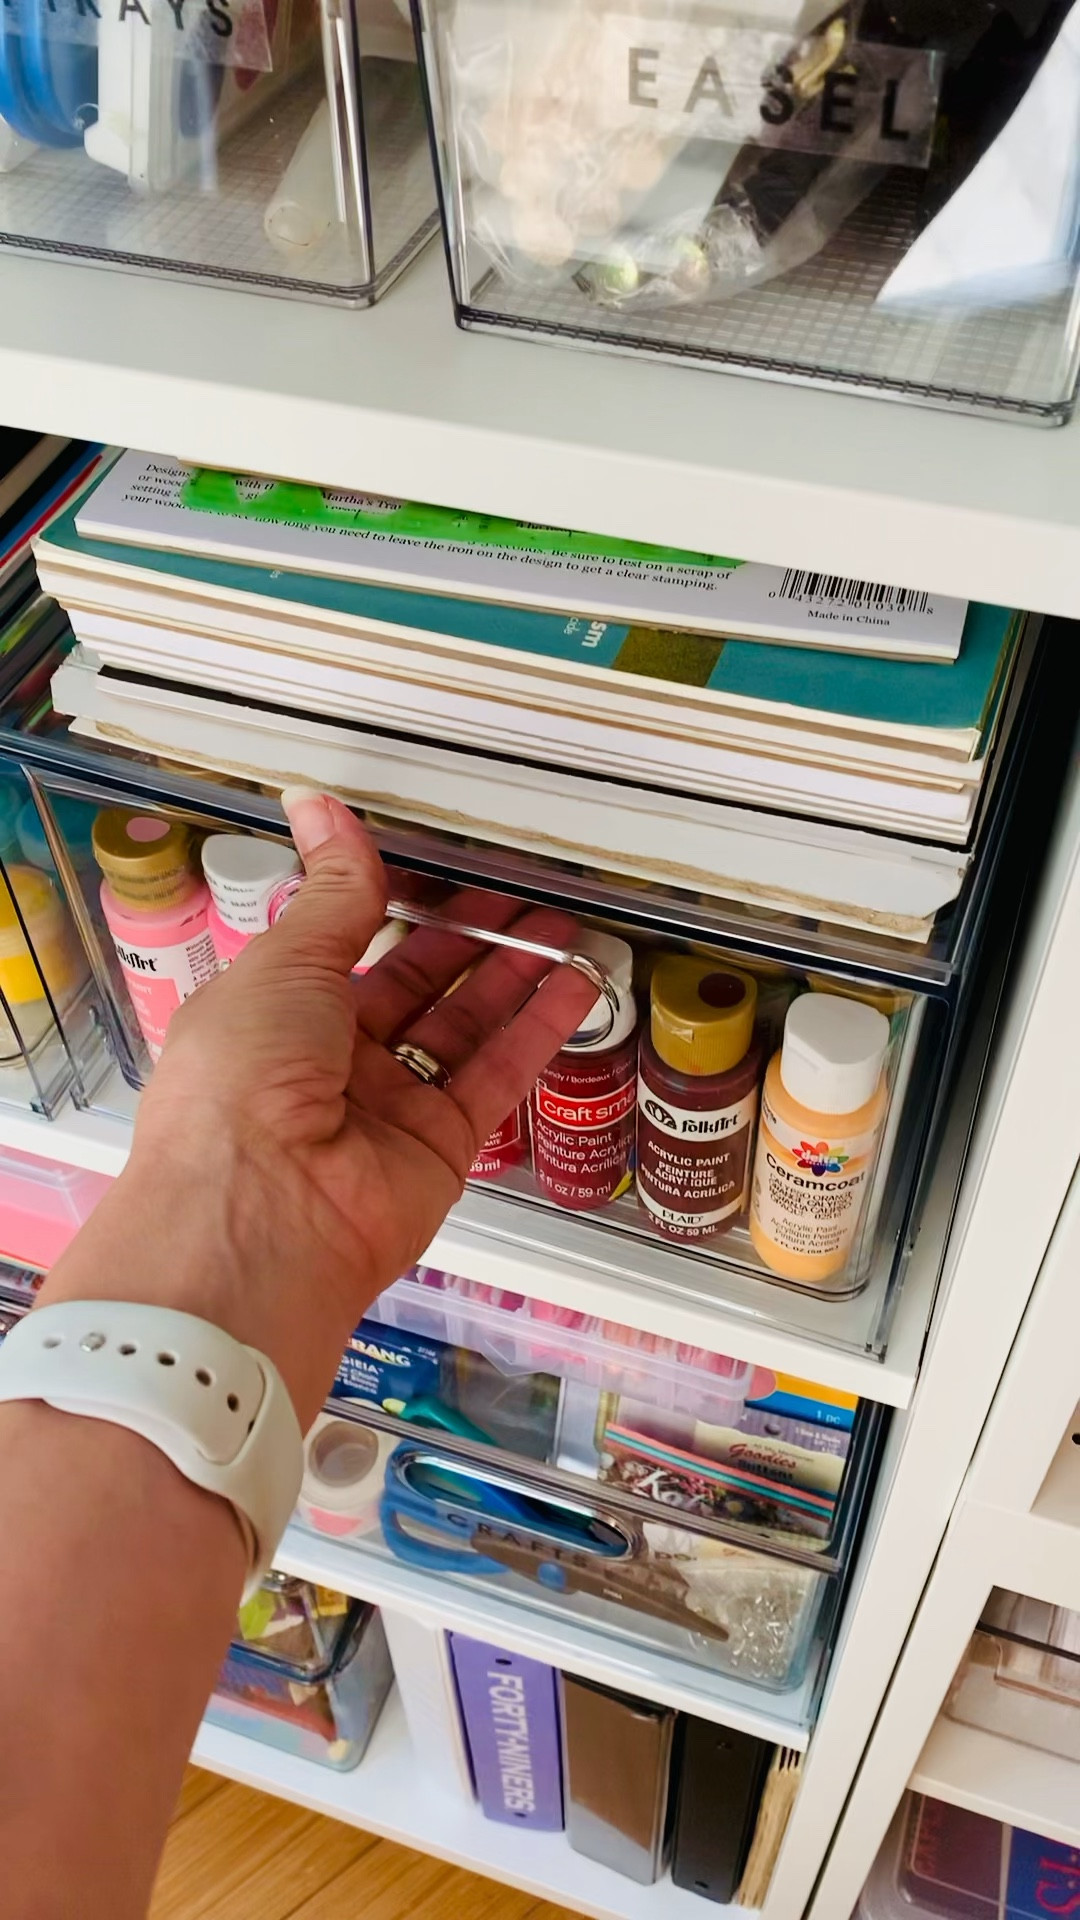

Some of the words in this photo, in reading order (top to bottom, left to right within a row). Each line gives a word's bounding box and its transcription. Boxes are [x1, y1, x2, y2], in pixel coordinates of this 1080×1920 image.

[627, 45, 911, 142] EASEL
[146, 464, 191, 478] Designs
[320, 490, 372, 507] Martha's
[122, 494, 152, 505] your
[313, 525, 337, 535] you
[339, 527, 370, 540] need
[372, 532, 386, 542] to
[388, 534, 421, 547] leave
[424, 540, 445, 551] the
[447, 543, 474, 556] iron
[476, 550, 493, 559] on
[497, 551, 518, 563] the
[520, 555, 563, 570] design
[566, 561, 579, 571] to
[581, 565, 602, 575] get
[617, 569, 650, 581] clear
[652, 574, 718, 591] stamping.
[130, 484, 172, 497] setting
[570, 551, 599, 562] sure
[602, 556, 616, 565] to
[619, 560, 642, 569] test
[645, 563, 663, 572] on
[677, 568, 714, 580] scrap
[716, 571, 733, 581] of
[807, 610, 839, 621] Made
[842, 614, 853, 623] in
[856, 615, 890, 626] China
[571, 1072, 610, 1084] Bordeaux
[544, 1100, 593, 1122] craft
[537, 1118, 575, 1146] Acrylic
[579, 1131, 612, 1147] Paint
[537, 1130, 586, 1161] Peinture
[538, 1144, 577, 1174] Pintura
[648, 1140, 693, 1167] ACRYLIC
[696, 1153, 730, 1167] PAINT
[658, 1160, 715, 1179] PEINTURE
[555, 1183, 568, 1196] oz
[578, 1187, 593, 1198] 59
[596, 1181, 611, 1196] ml
[662, 1209, 703, 1225] PLAID
[668, 1224, 685, 1235] OZ
[686, 1227, 700, 1237] 59
[825, 1415, 841, 1425] pc
[728, 1443, 797, 1469] Goodies
[446, 1512, 589, 1569] CRAFTS
[487, 1671, 536, 1813] FORTY-NINERS
